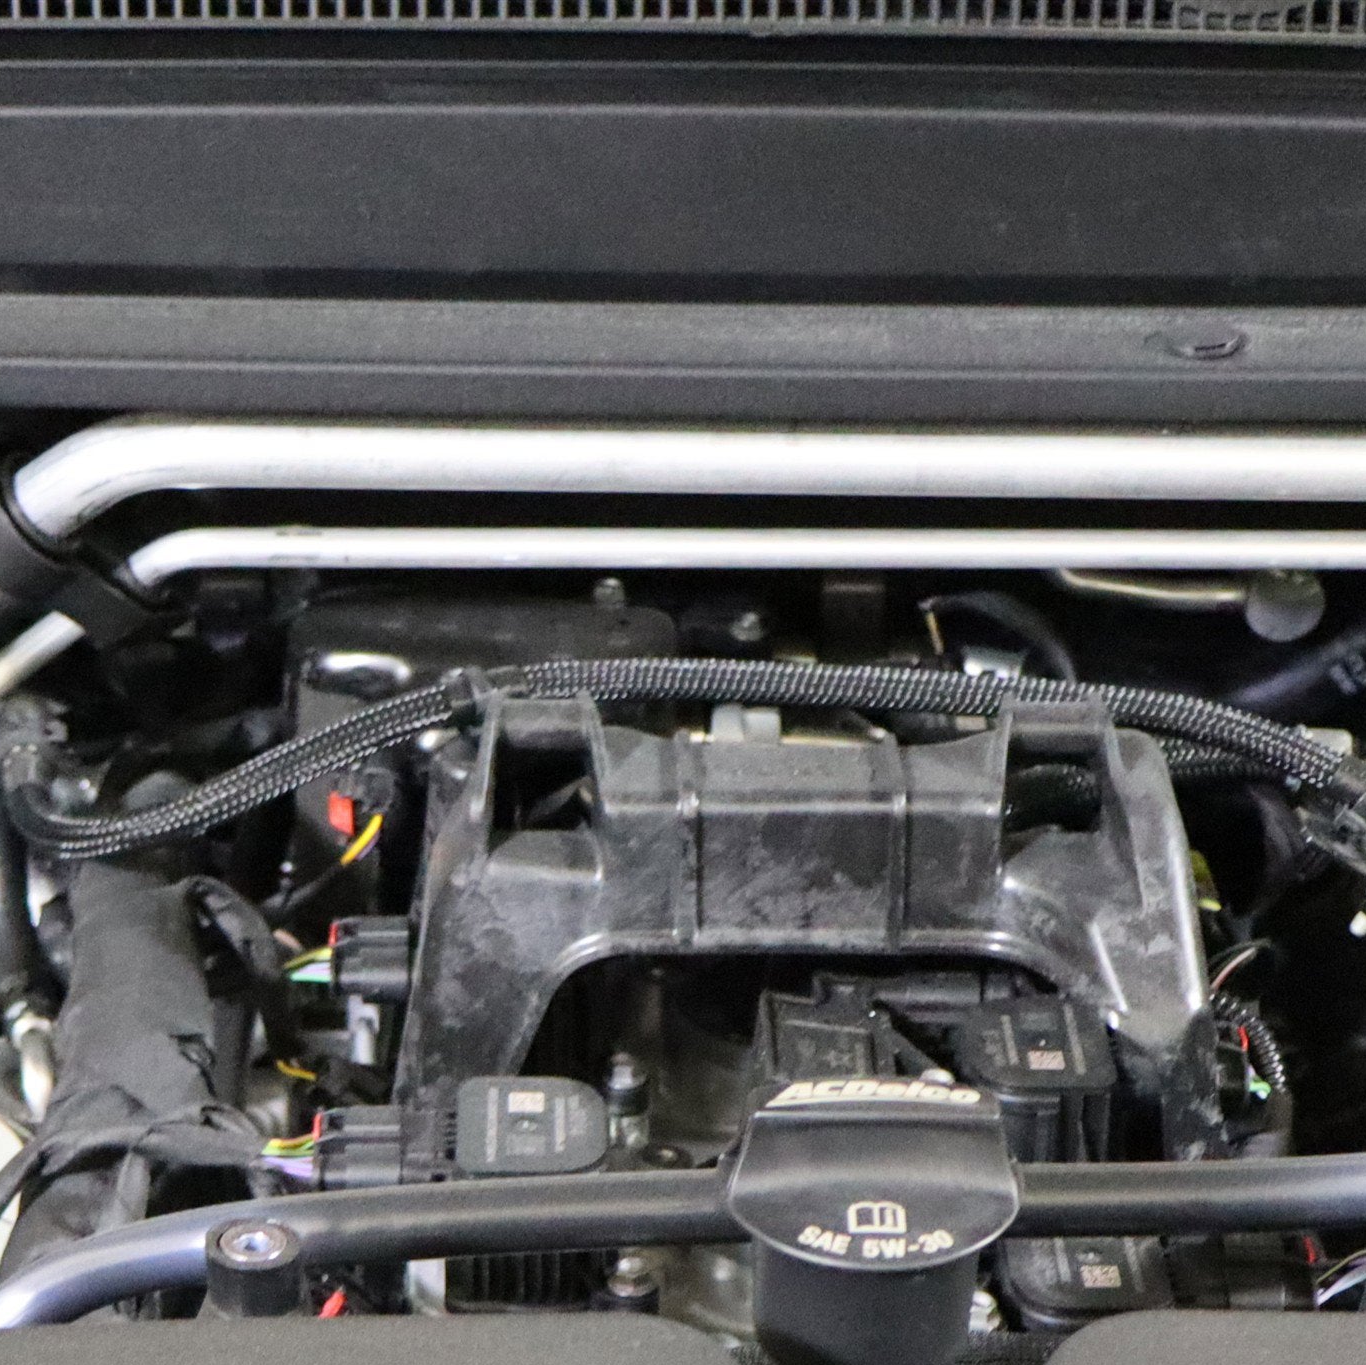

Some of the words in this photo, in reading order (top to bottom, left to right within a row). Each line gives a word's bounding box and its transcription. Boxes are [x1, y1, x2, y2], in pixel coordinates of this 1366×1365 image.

[766, 1079, 981, 1107] ACDelco
[797, 1225, 852, 1255] SAE
[862, 1229, 954, 1258] 5W-30
